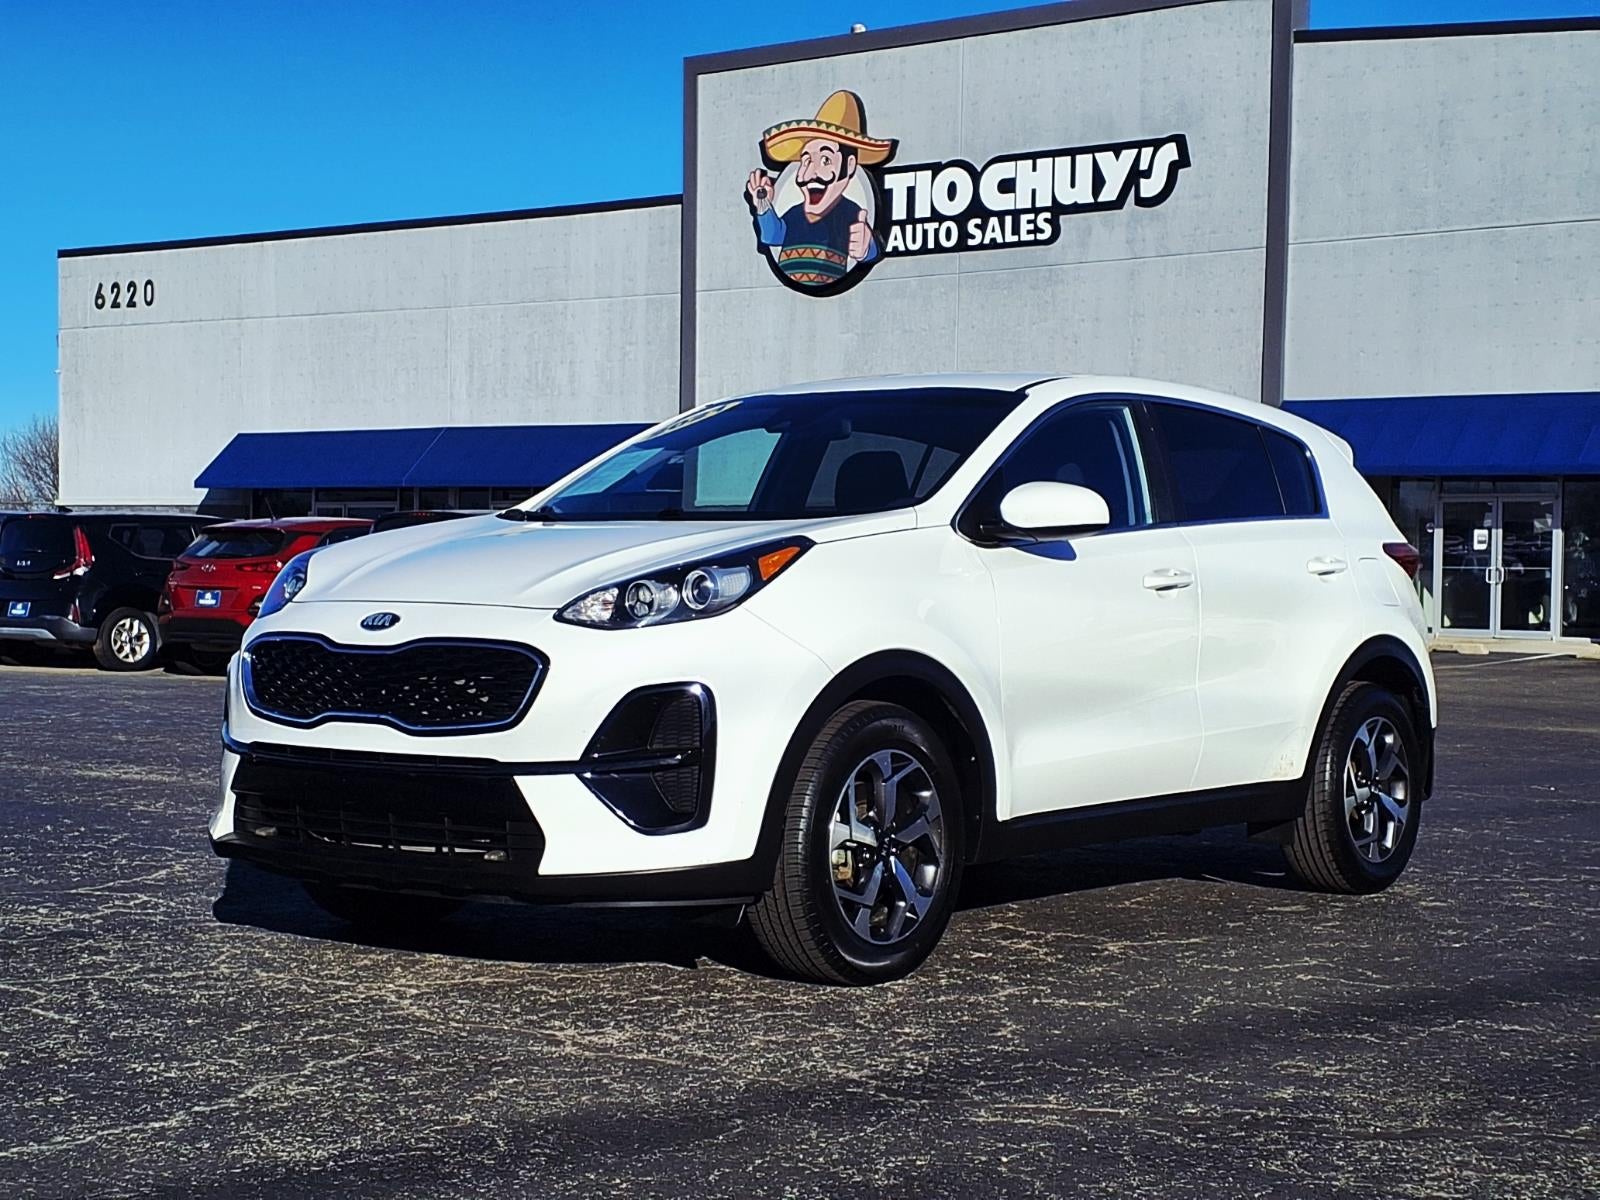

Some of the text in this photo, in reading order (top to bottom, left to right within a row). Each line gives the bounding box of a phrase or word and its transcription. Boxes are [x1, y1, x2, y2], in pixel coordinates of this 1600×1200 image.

[884, 141, 1180, 221] TIO CHUY'S
[885, 212, 1053, 252] AUTO SALES
[94, 279, 155, 310] 6220
